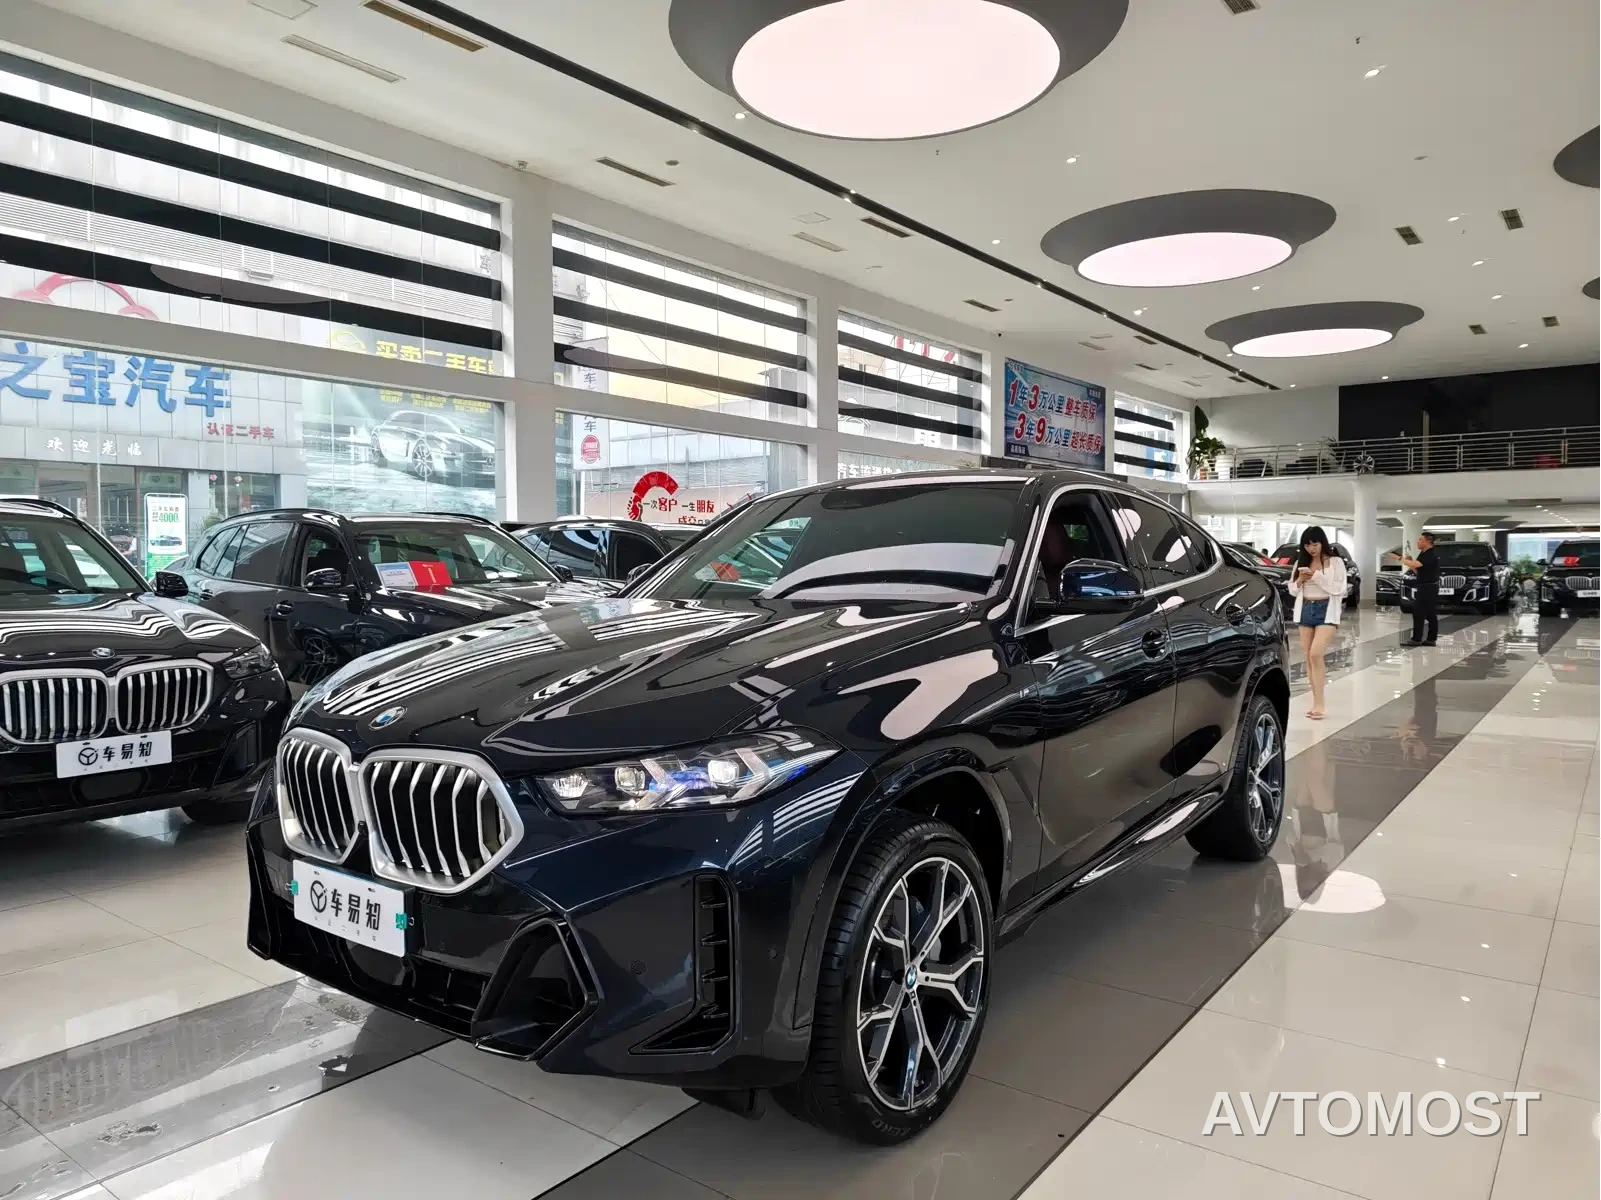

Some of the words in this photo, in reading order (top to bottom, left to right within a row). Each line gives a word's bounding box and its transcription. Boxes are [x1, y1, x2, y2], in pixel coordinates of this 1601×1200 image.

[0, 342, 232, 417] 之宝汽车
[1009, 378, 1098, 422] 1年3万公里整车质保
[206, 422, 275, 440] 认证二手车
[47, 436, 142, 457] 欢迎光临
[643, 497, 678, 512] 一次客户
[681, 500, 715, 513] 一生朋友
[102, 741, 152, 761] 车易知
[331, 888, 381, 931] 车易知
